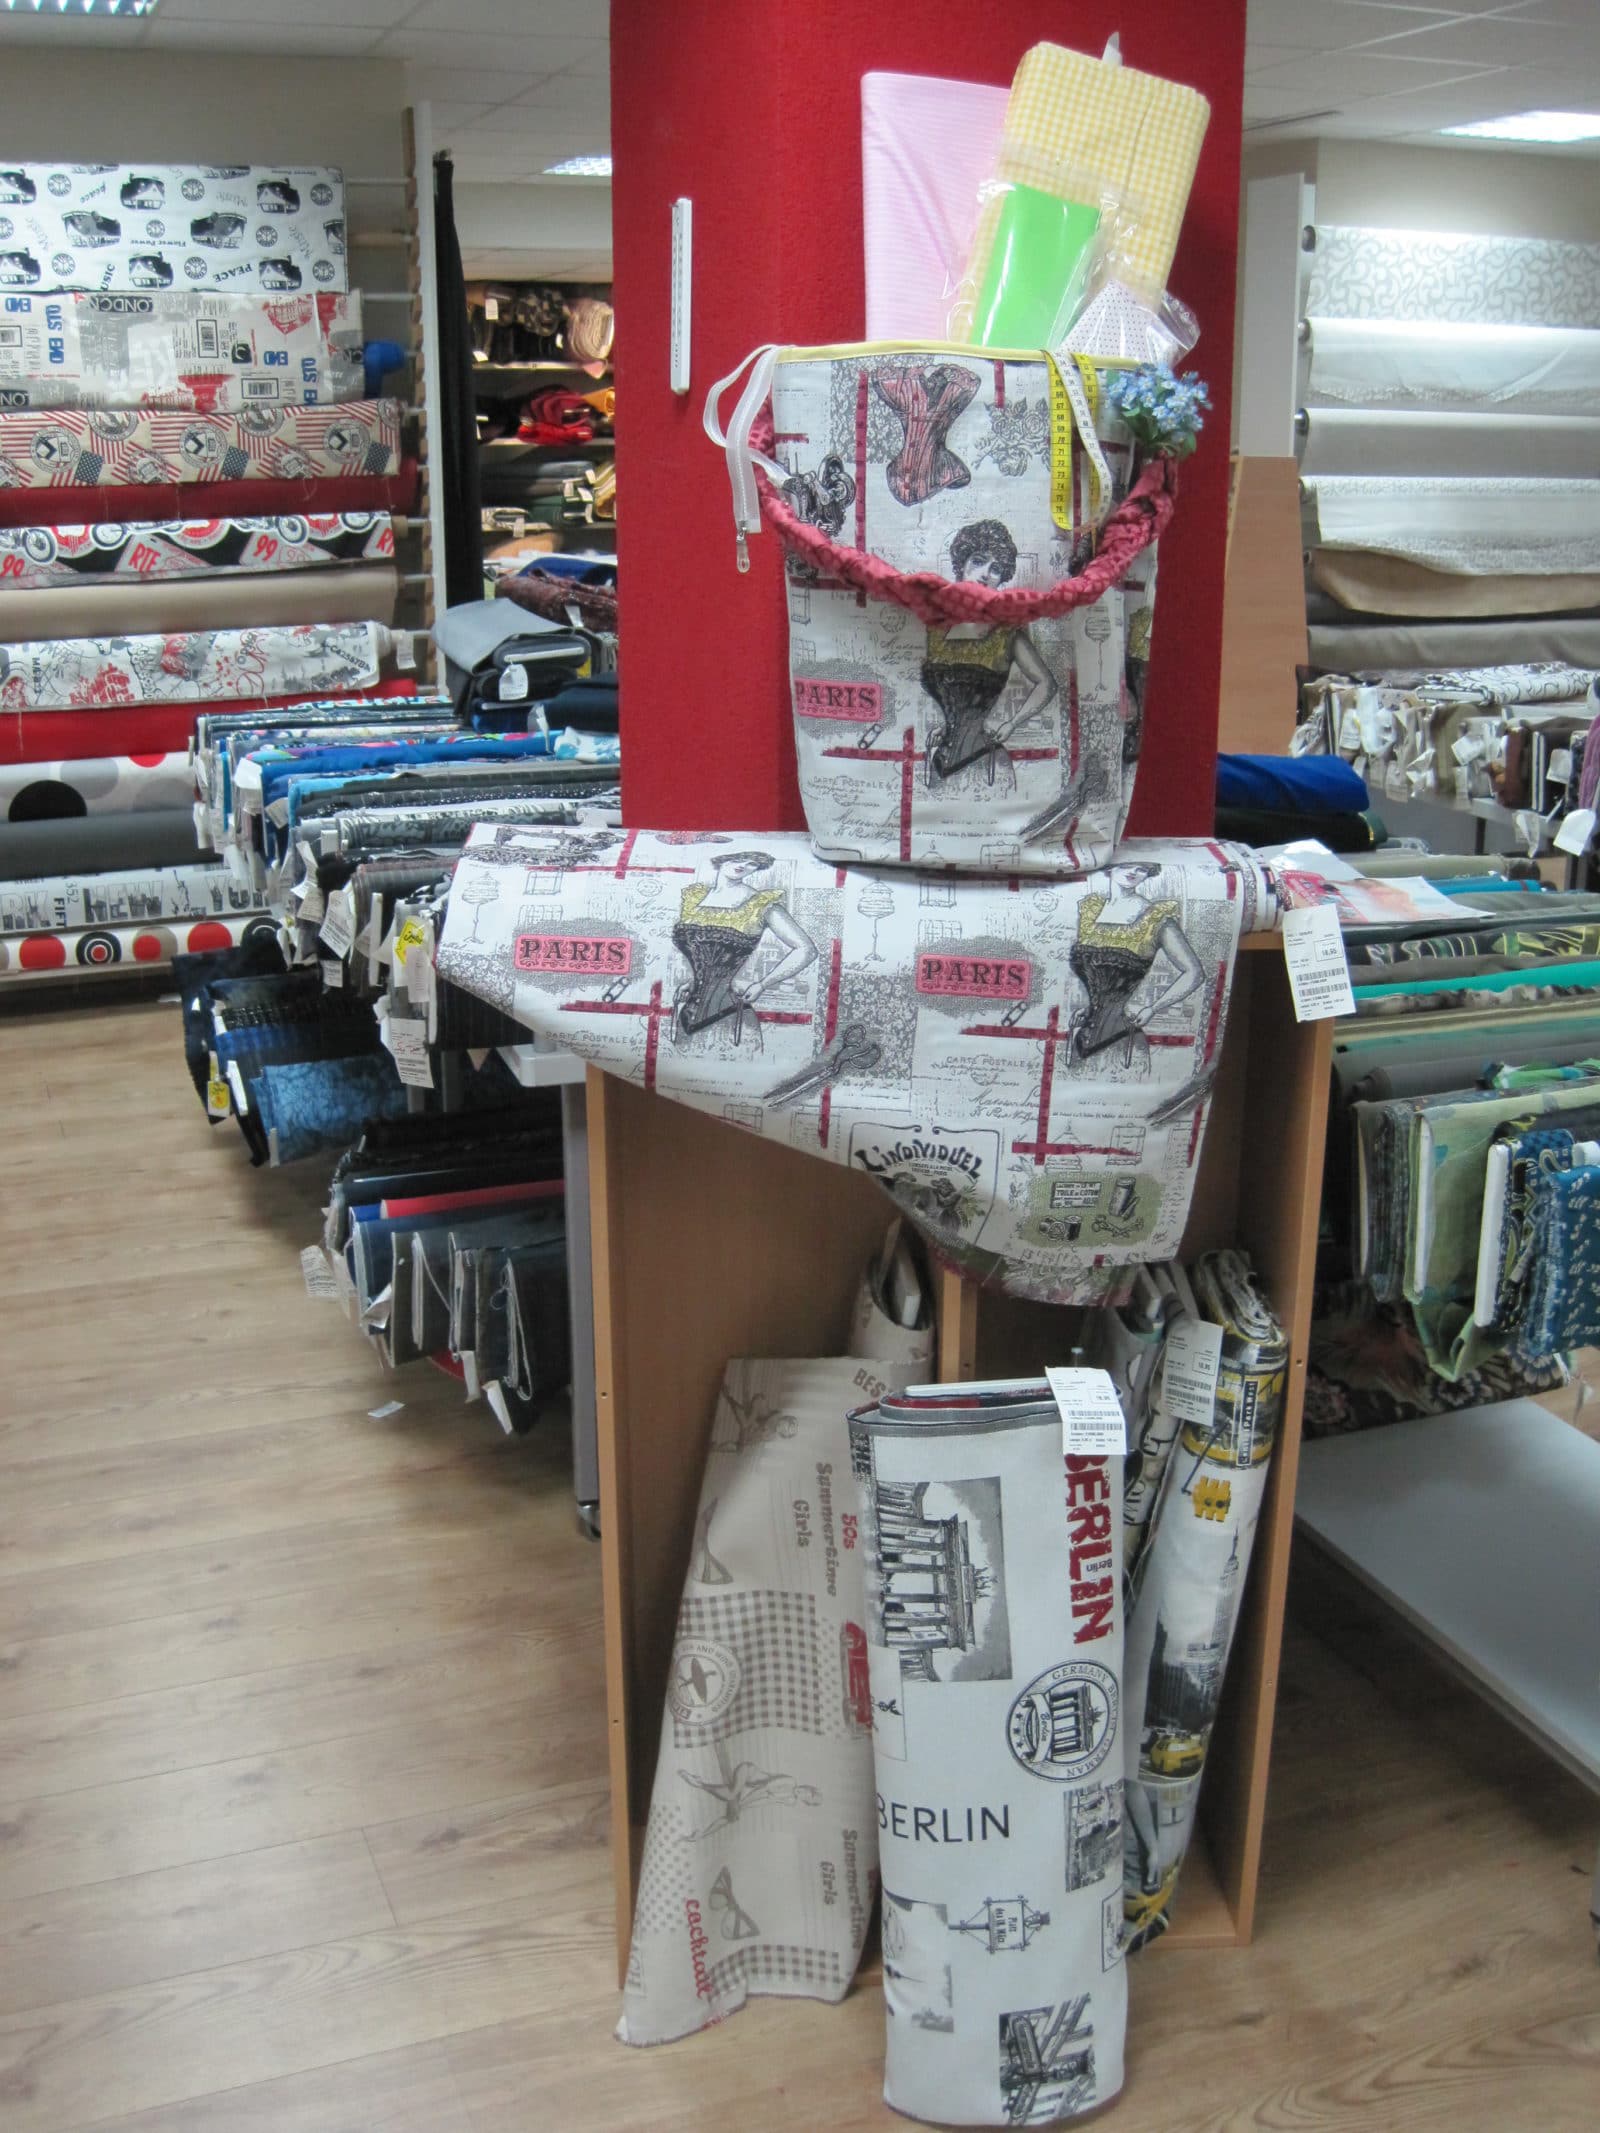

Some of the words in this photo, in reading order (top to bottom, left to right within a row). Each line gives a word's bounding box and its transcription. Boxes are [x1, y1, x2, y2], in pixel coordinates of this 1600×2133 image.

[101, 263, 116, 291] USIC
[214, 263, 253, 283] PEACE
[796, 683, 878, 710] PARIS
[521, 938, 628, 963] PARIS
[922, 957, 1024, 987] PARIS
[1086, 1558, 1113, 1572] Berlin
[1052, 1665, 1108, 1682] GERMANY
[876, 1792, 1009, 1843] BERLIN
